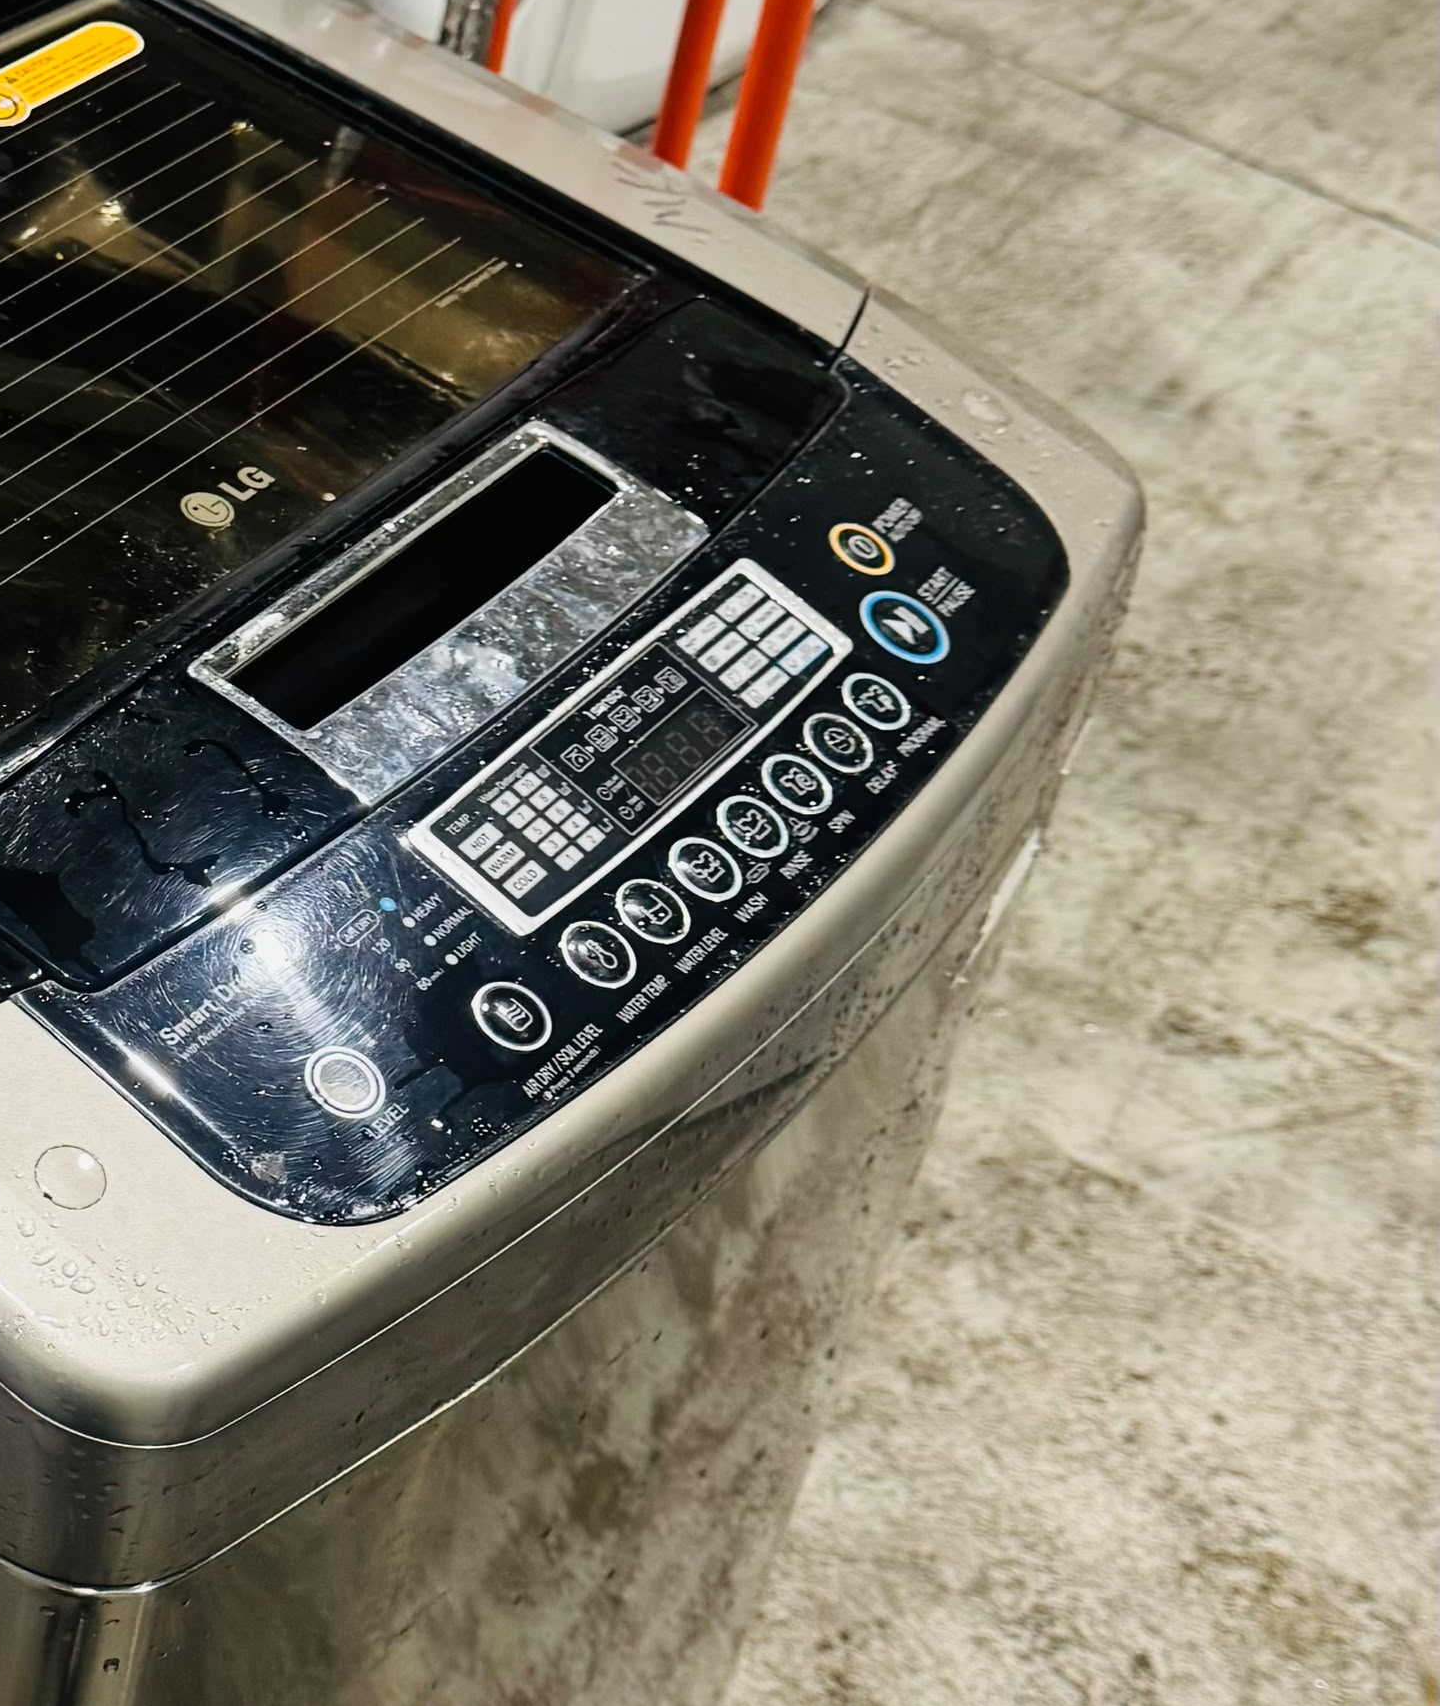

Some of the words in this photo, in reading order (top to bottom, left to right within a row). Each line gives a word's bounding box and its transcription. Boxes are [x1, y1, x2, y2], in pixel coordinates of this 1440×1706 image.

[217, 466, 276, 502] LG
[917, 566, 954, 602] START
[935, 581, 977, 617] PAUSE
[827, 809, 856, 834] SPIN
[471, 833, 491, 851] HOT
[488, 848, 519, 874] WARM
[512, 869, 538, 891] COLD
[411, 892, 444, 922] HEAVY
[432, 905, 474, 940] NORMAL
[733, 891, 769, 923] WASH
[371, 937, 391, 955] 120
[453, 931, 484, 959] LIGHT
[673, 946, 706, 974] WATER
[698, 927, 729, 954] LEVEL
[160, 998, 220, 1046] Smart
[615, 994, 651, 1024] WATER
[522, 1078, 543, 1099] AIR
[536, 1064, 557, 1086] DRY
[575, 1022, 603, 1048] LEVEL
[370, 1103, 410, 1141] LEVEL
